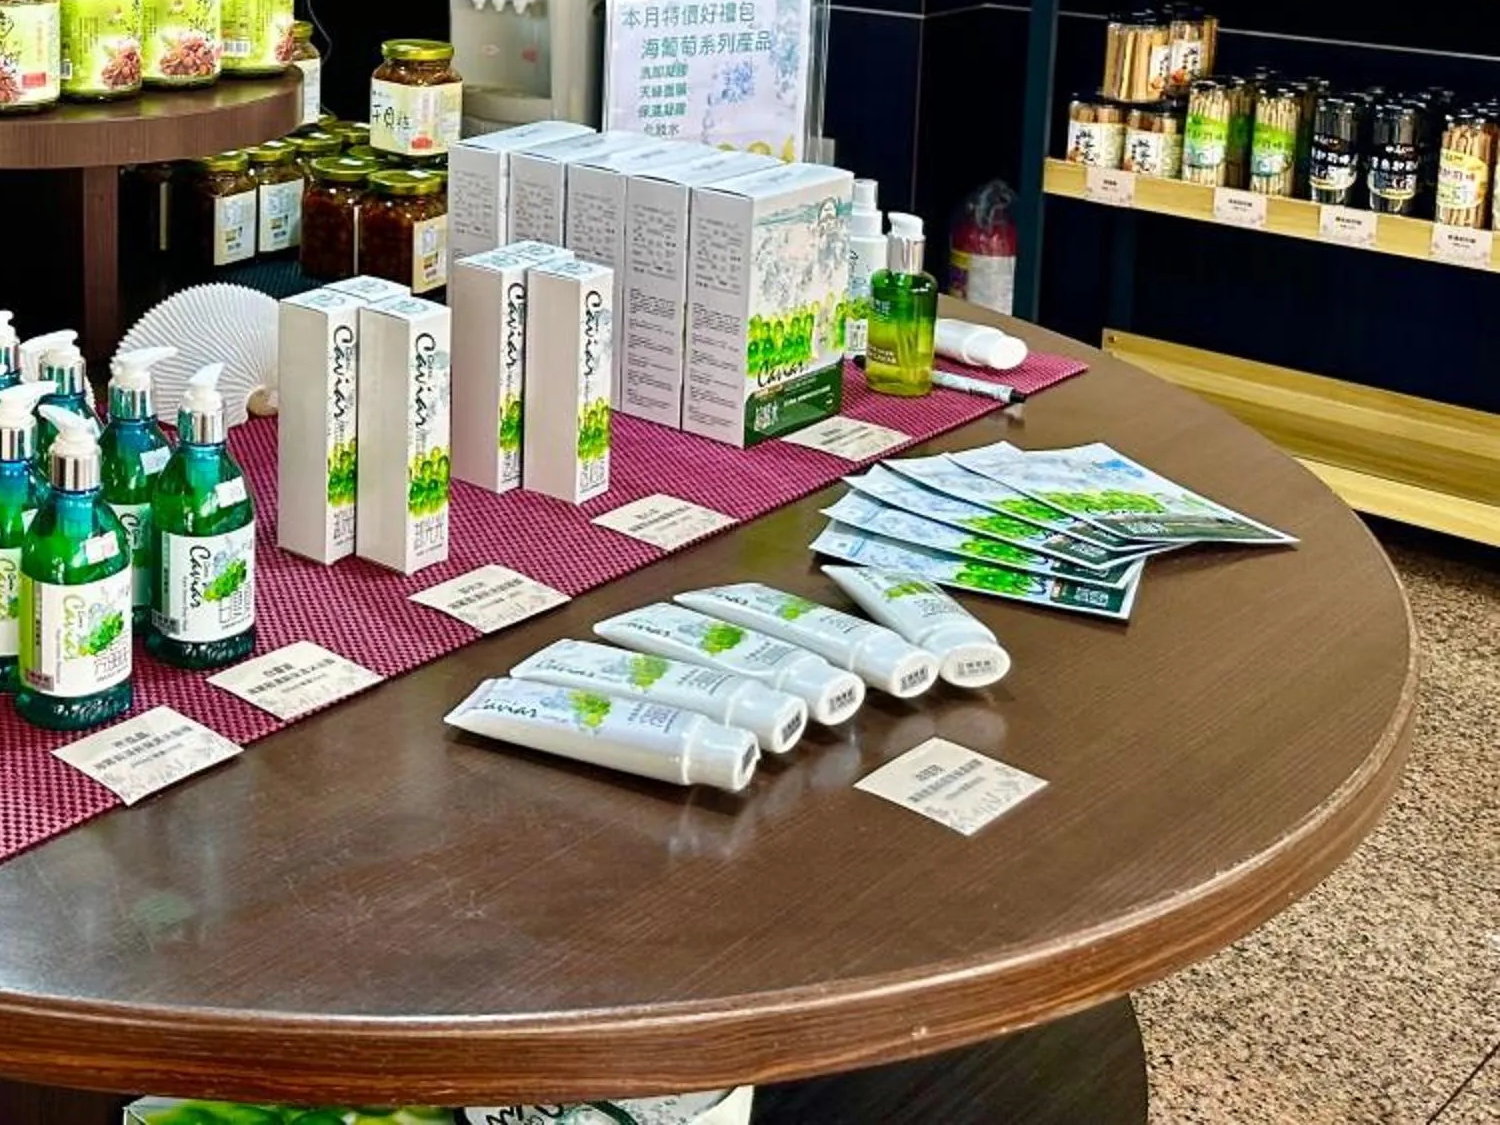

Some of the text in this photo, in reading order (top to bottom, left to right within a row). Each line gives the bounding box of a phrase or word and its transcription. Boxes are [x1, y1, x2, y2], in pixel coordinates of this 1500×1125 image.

[621, 1, 756, 29] 本月特價好禮包
[640, 30, 772, 60] 海葡萄系列產品
[505, 282, 527, 369] Caviar
[583, 290, 603, 376] Caviar
[333, 324, 354, 419] Caviar
[414, 332, 437, 428] Caviar
[188, 545, 211, 608] Caviar
